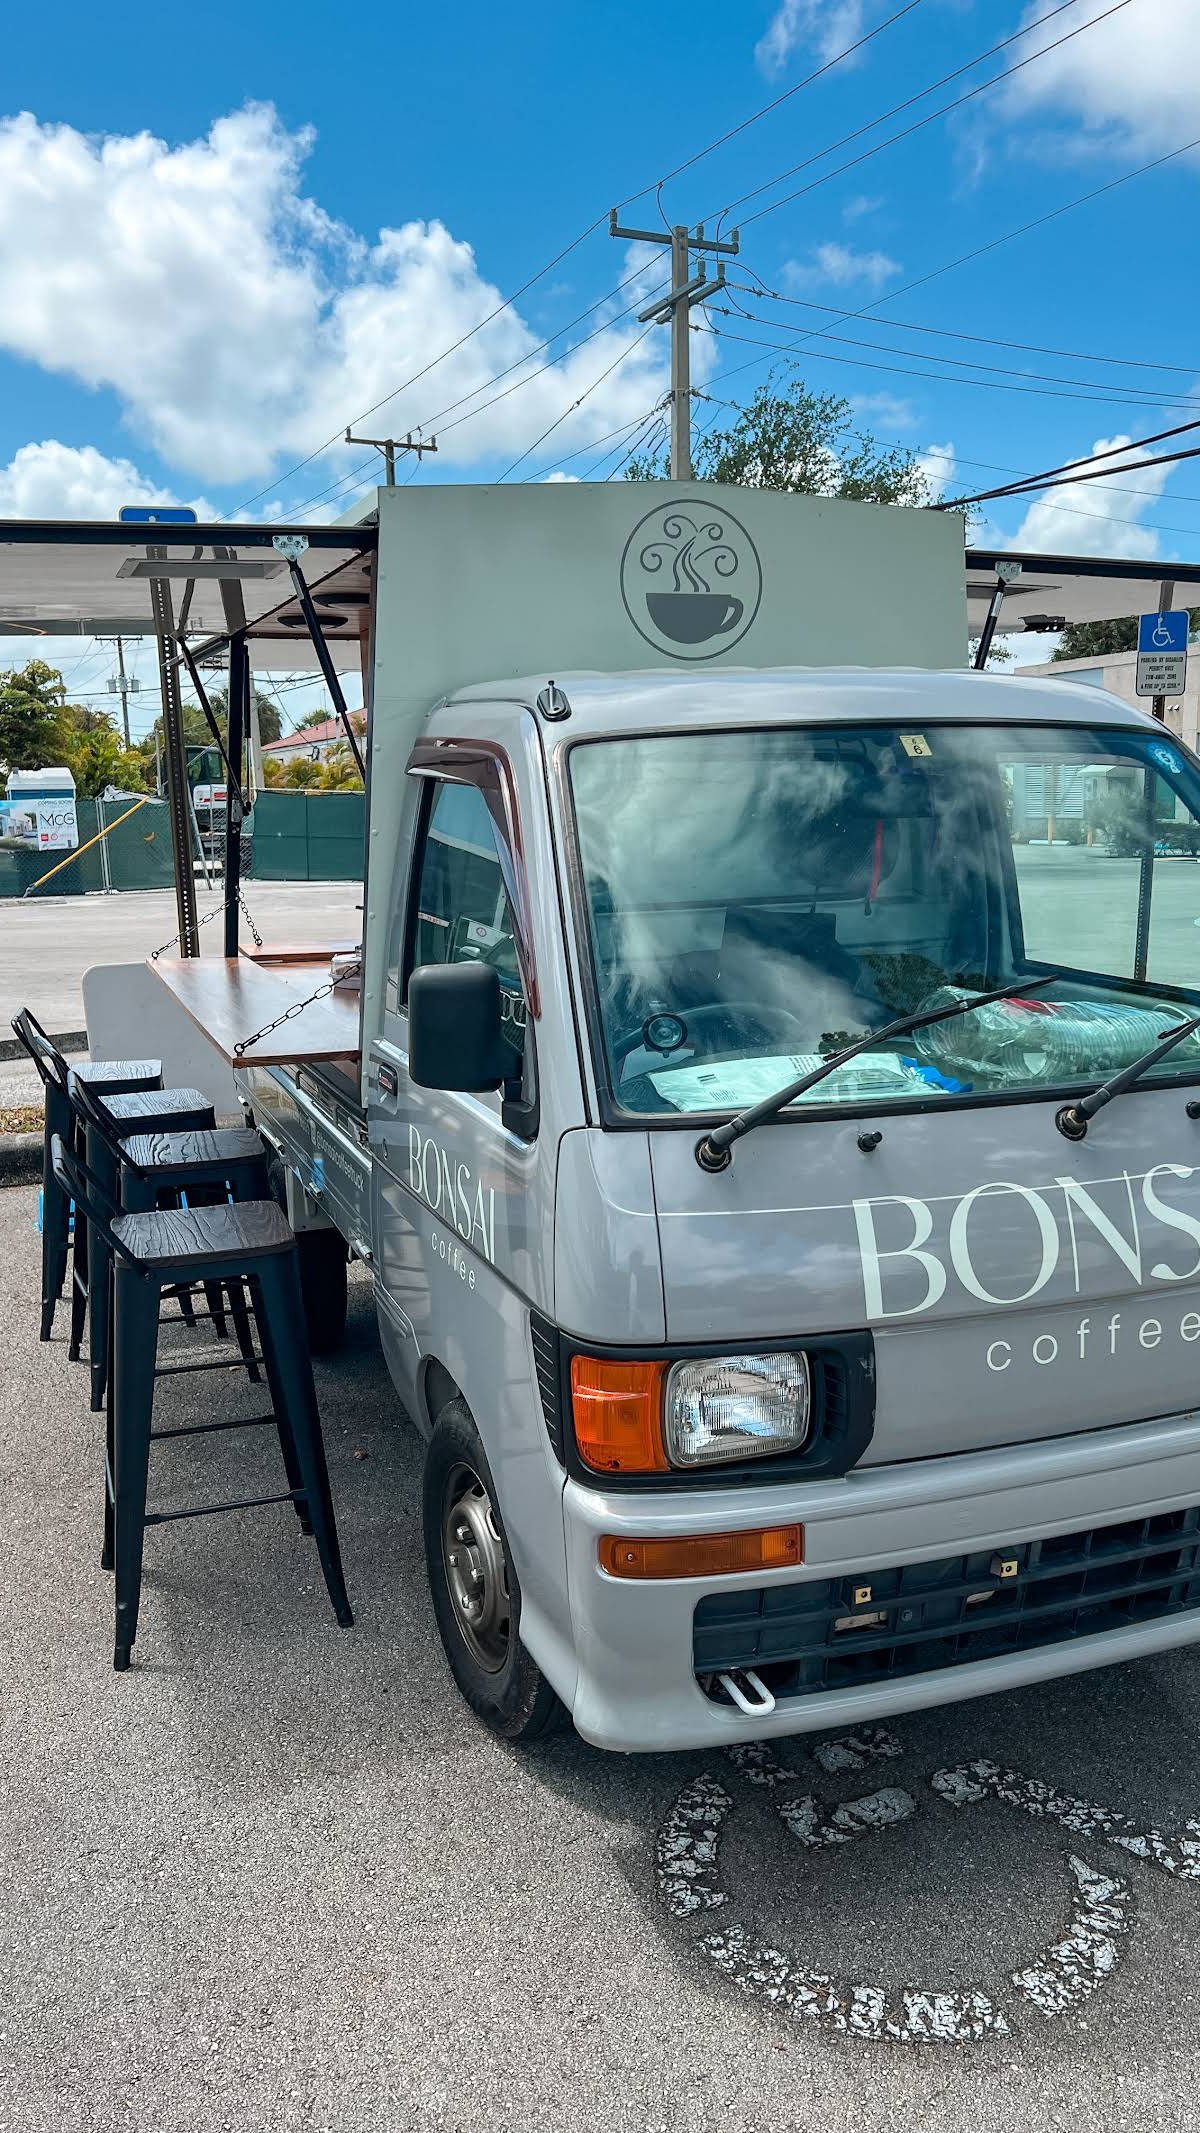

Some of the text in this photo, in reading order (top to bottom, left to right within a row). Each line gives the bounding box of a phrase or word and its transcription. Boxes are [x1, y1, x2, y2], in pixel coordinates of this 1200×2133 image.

[409, 1124, 495, 1265] BONSAI
[852, 1163, 1200, 1320] BONS
[431, 1232, 476, 1290] coffee
[986, 1312, 1200, 1371] coffee
